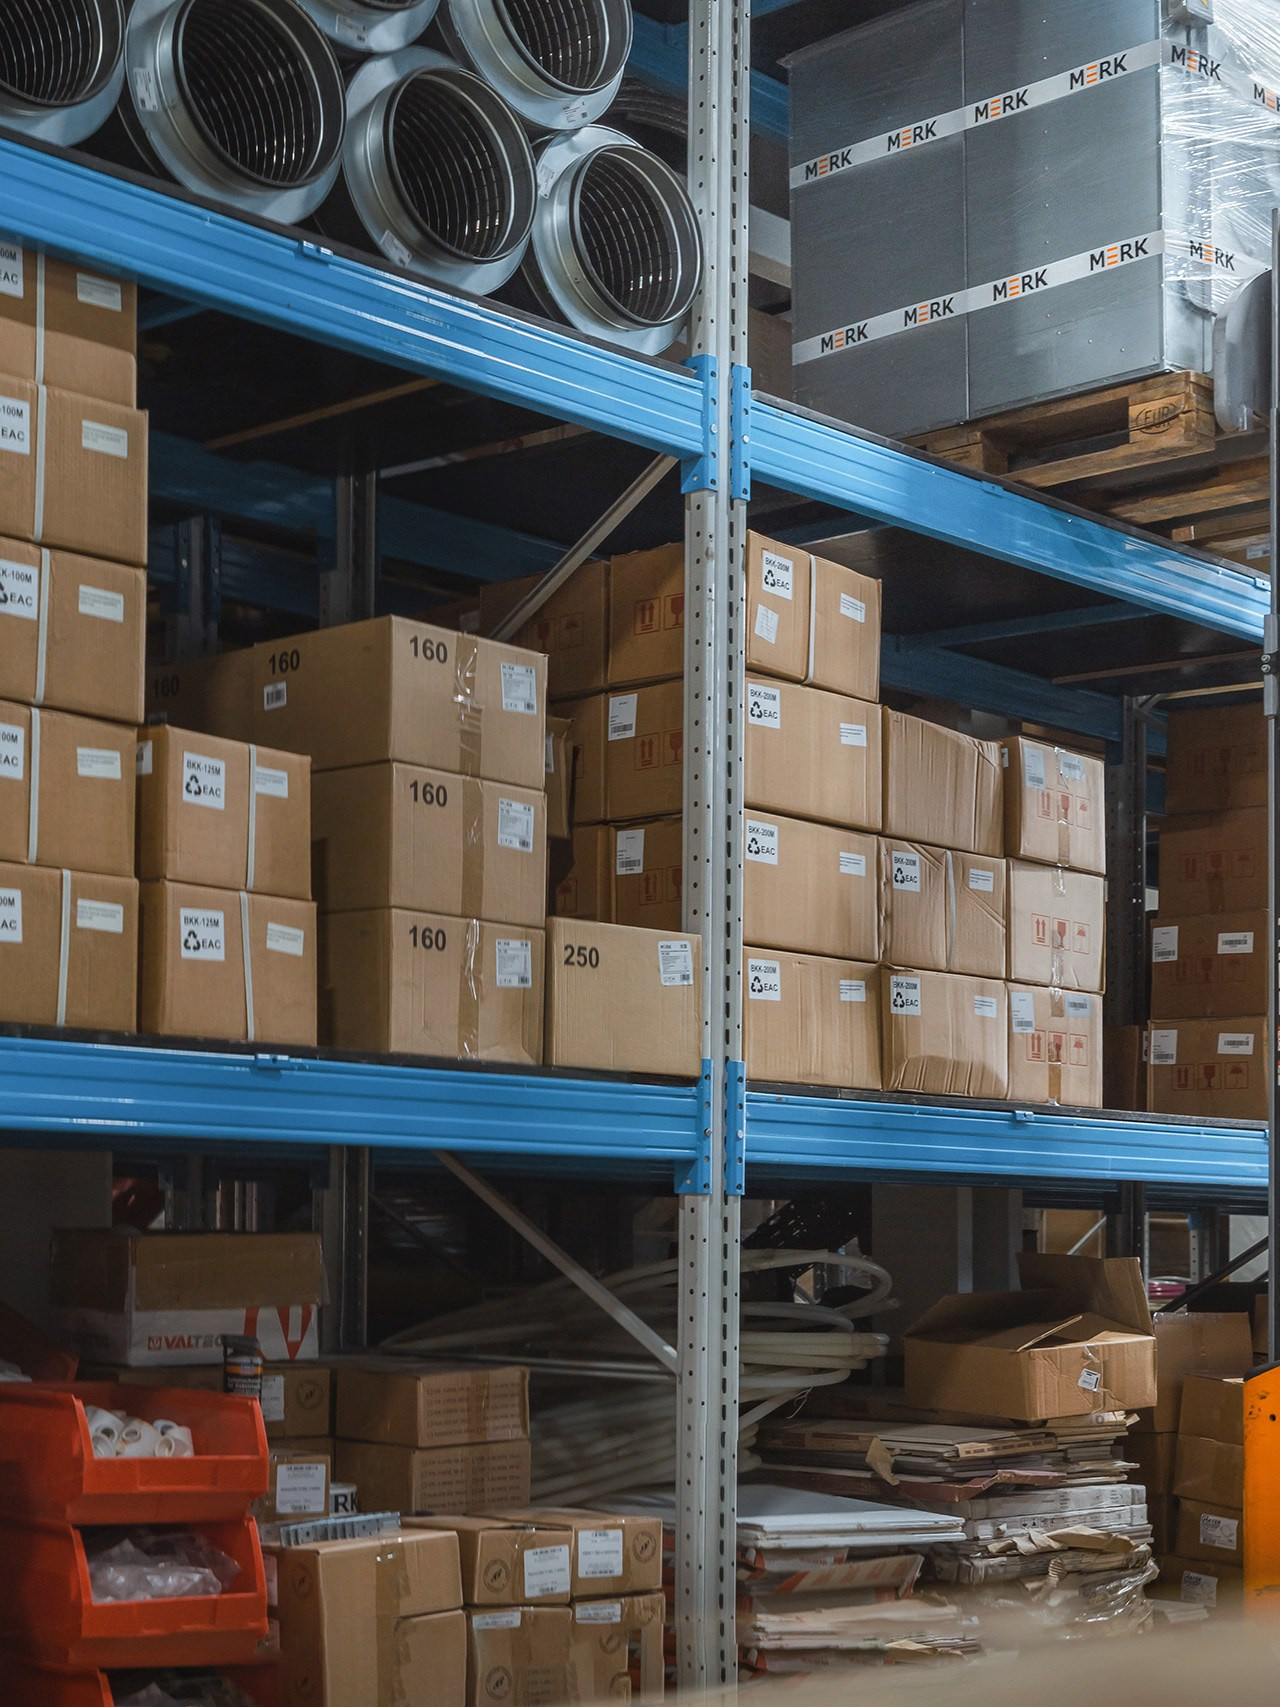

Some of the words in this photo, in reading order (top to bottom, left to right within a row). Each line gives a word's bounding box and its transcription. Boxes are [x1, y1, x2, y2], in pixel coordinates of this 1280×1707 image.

[1070, 54, 1127, 90] MERK
[1171, 45, 1221, 81] MERK
[974, 89, 1029, 123] MERK
[887, 120, 937, 151] MERK
[805, 149, 852, 181] MERK
[1090, 237, 1149, 271] MERK
[1189, 240, 1236, 271] MERK
[993, 268, 1048, 301] MERK
[904, 297, 954, 327] MERK
[820, 322, 868, 353] MERK
[1, 429, 25, 442] EAC
[776, 578, 790, 591] EAC
[9, 592, 33, 607] EAC
[269, 649, 300, 675] 160
[409, 635, 448, 664] 160
[763, 710, 778, 720] EAC
[186, 759, 221, 776] BKK-125M
[203, 786, 222, 798] EAC
[409, 780, 447, 807] 160
[761, 846, 775, 856] EAC
[905, 874, 918, 884] EAC
[184, 915, 220, 928] BKK-125M
[202, 938, 221, 950] EAC
[408, 925, 446, 951] 160
[564, 944, 600, 969] 250
[764, 983, 778, 992] EAC
[905, 999, 919, 1008] EAC
